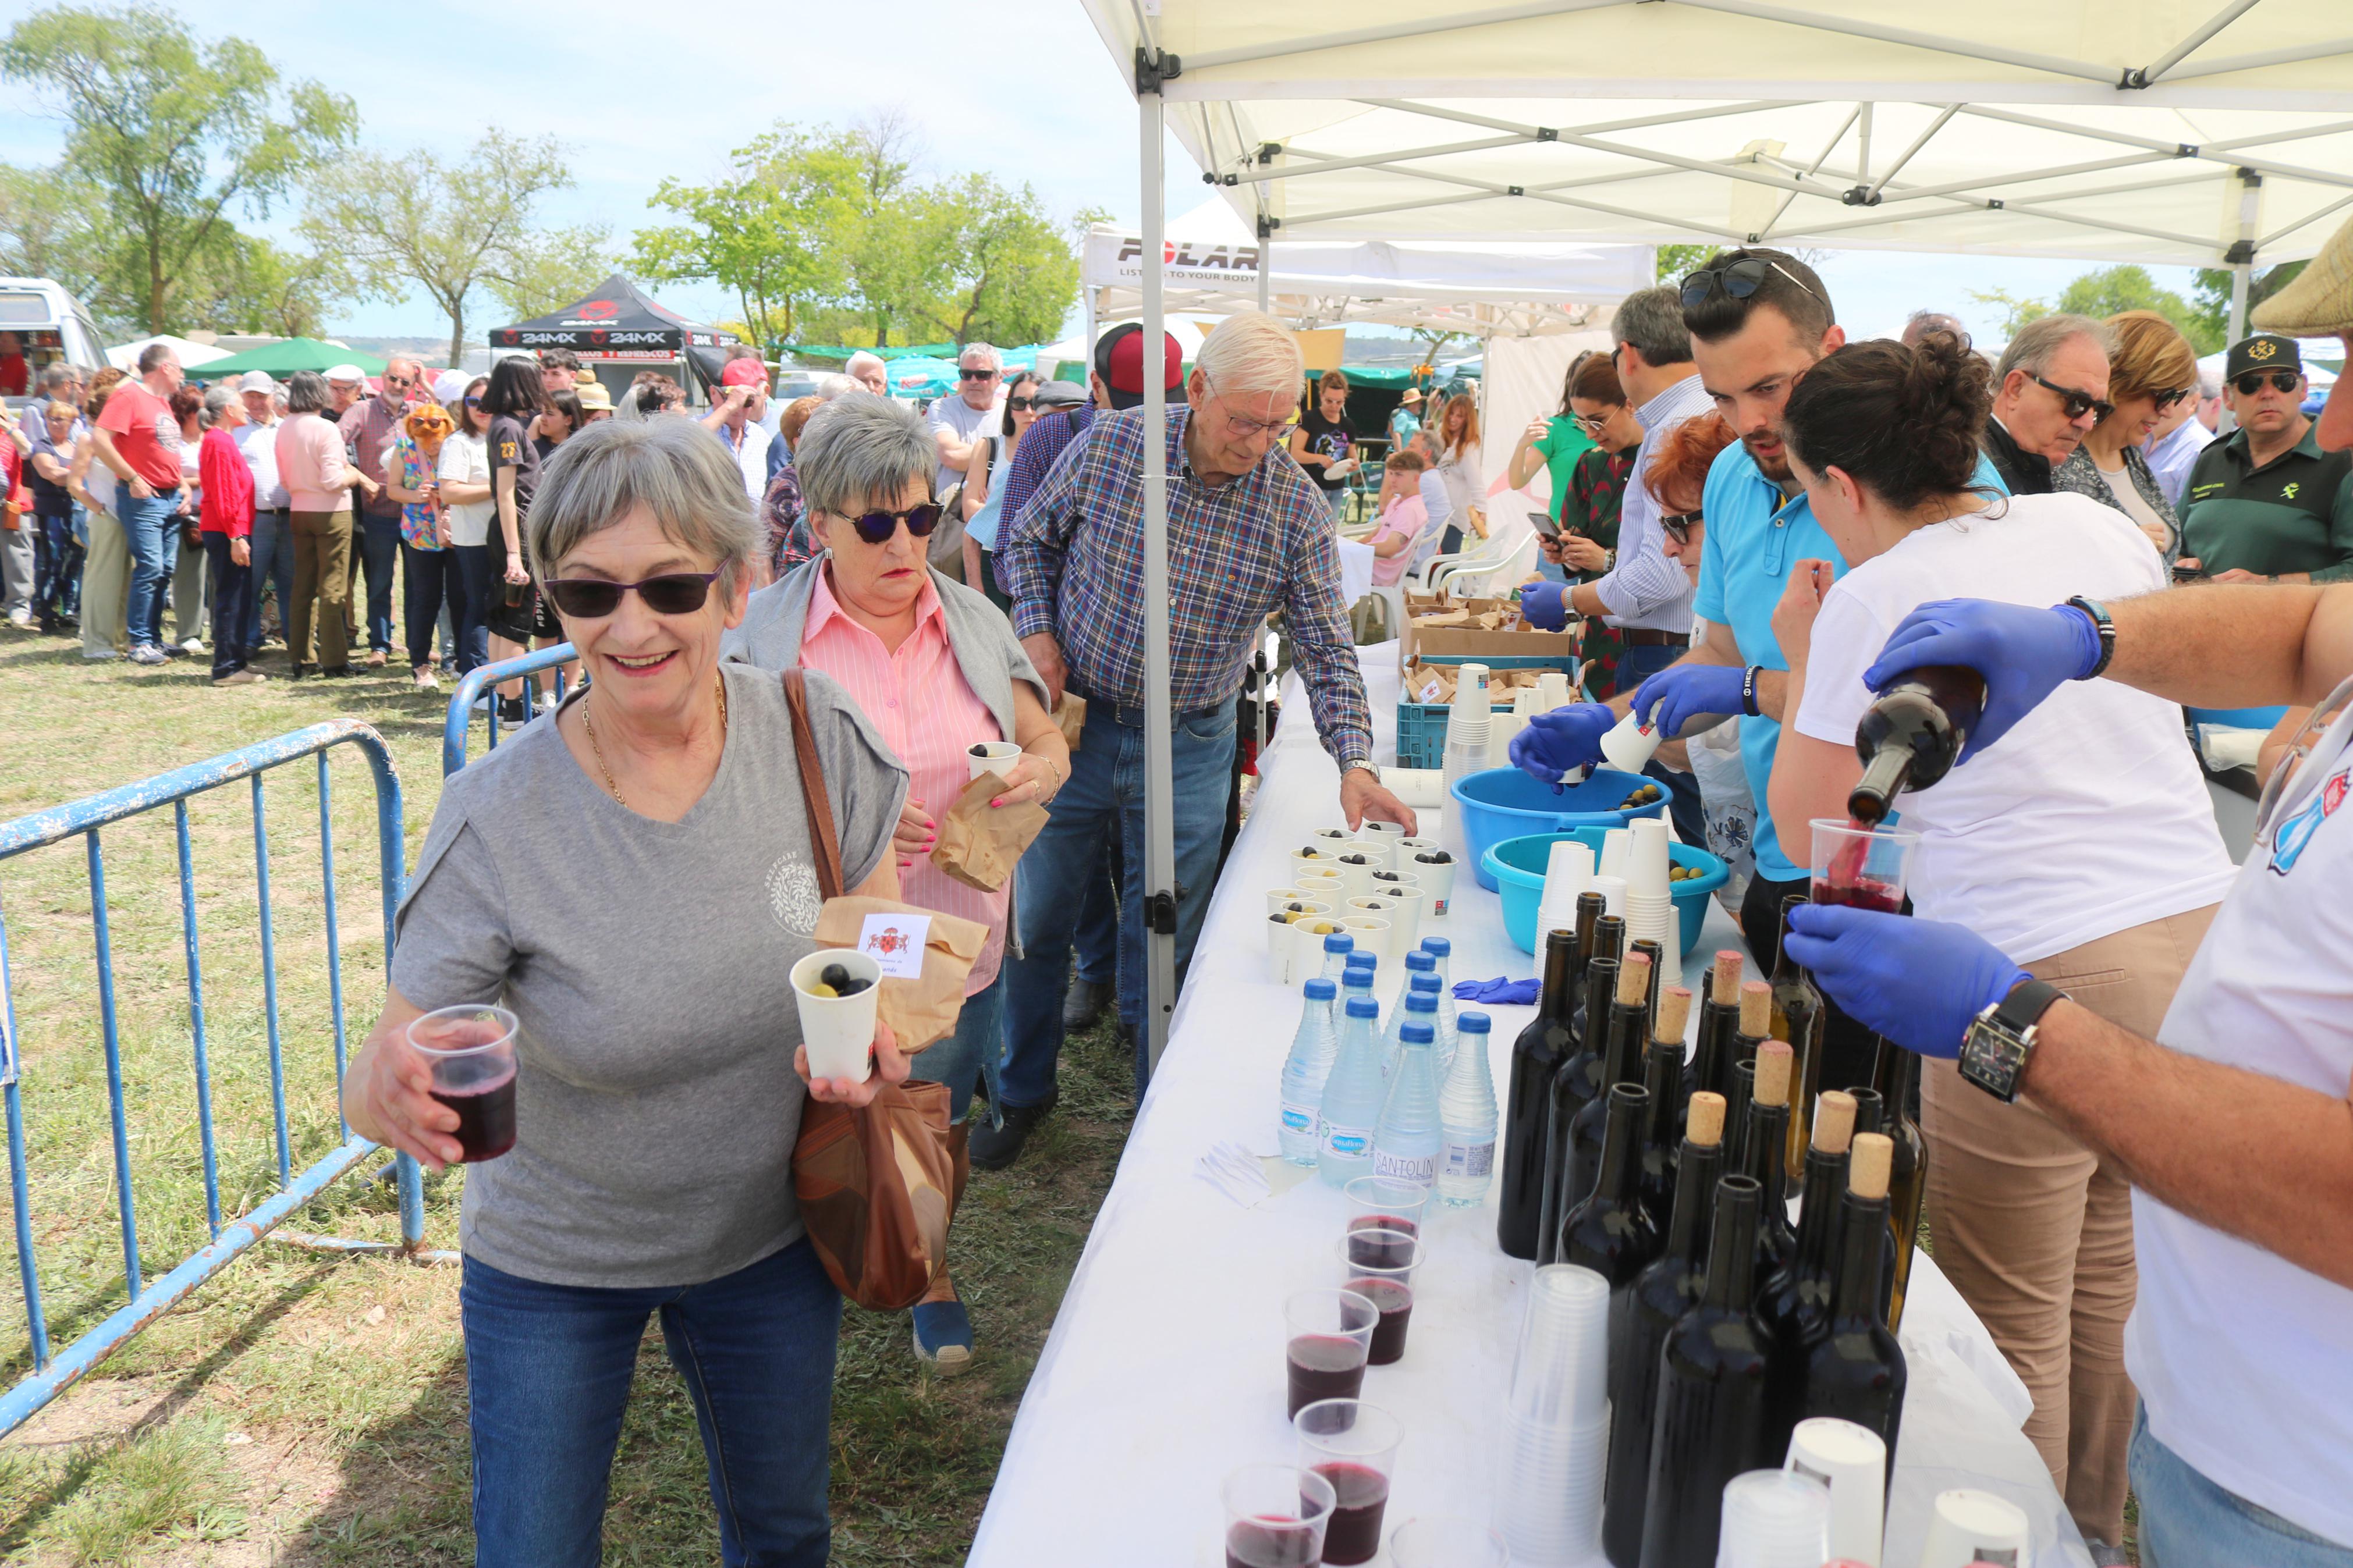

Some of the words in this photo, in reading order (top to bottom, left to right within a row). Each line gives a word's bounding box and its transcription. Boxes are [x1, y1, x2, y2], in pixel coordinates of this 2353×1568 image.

[1188, 272, 1220, 280] YOUR
[1223, 274, 1257, 282] BODY
[521, 333, 577, 343] 24MX
[609, 332, 666, 343] 24MX
[1377, 1153, 1434, 1175] SANTOLÍN
